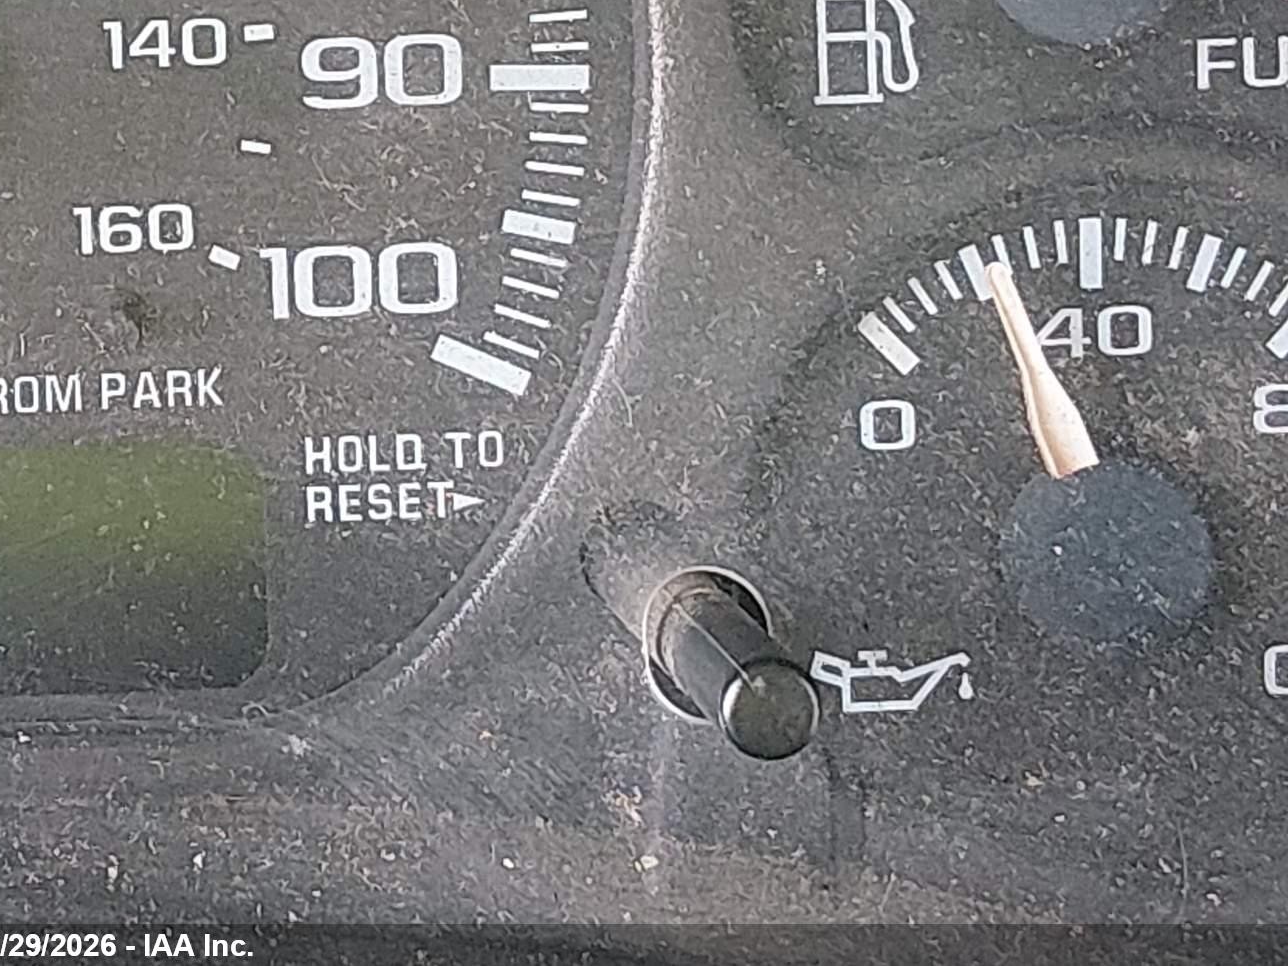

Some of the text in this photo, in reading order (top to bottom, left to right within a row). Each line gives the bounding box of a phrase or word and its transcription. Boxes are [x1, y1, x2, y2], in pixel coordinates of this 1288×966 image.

[103, 18, 227, 70] 140
[301, 33, 463, 110] 90
[73, 203, 194, 255] 160
[259, 242, 458, 320] 100
[1036, 305, 1153, 360] 40
[101, 367, 223, 410] PARK
[859, 399, 916, 451] 0
[304, 430, 504, 475] HOLD TO
[306, 479, 454, 523] RESET
